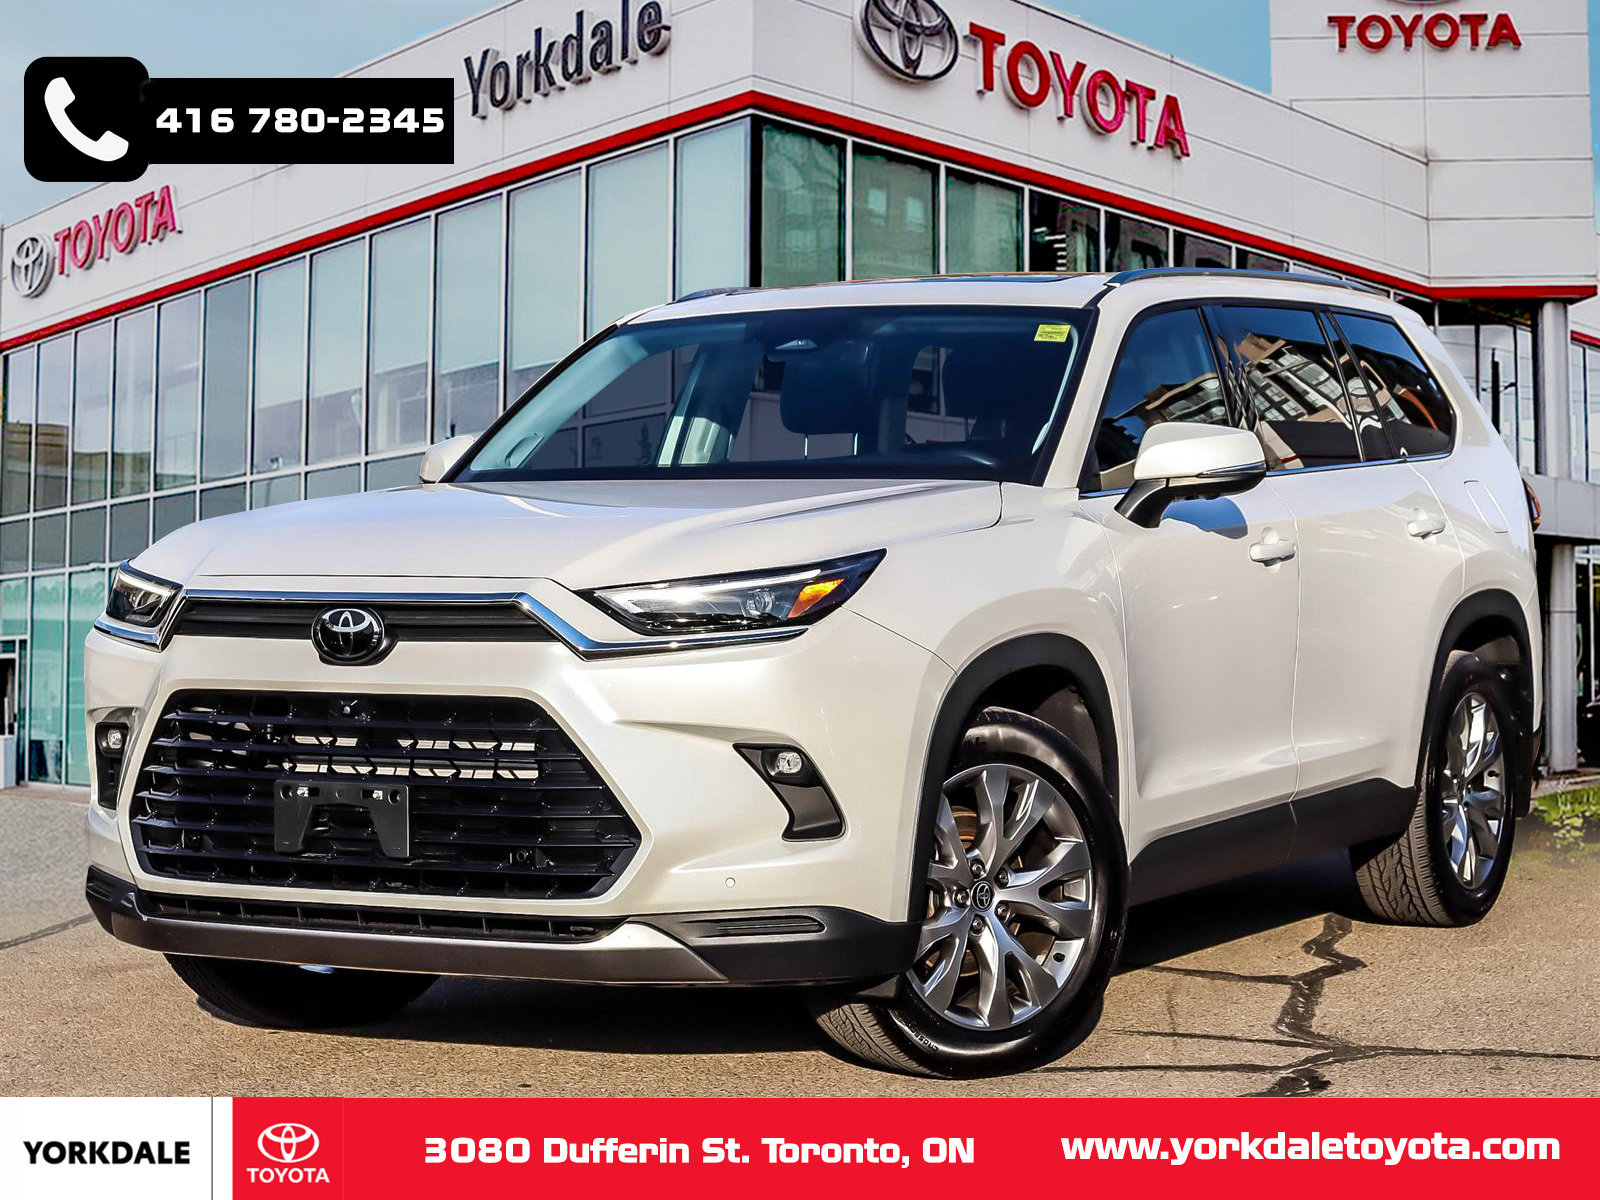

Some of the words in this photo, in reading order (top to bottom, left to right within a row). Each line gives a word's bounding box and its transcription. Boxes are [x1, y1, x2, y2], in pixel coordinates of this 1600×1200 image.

[463, 0, 671, 118] Yorkdale
[1327, 12, 1522, 51] TOYOTA
[965, 21, 1191, 159] TOYOTA
[53, 184, 180, 276] TOYOTA
